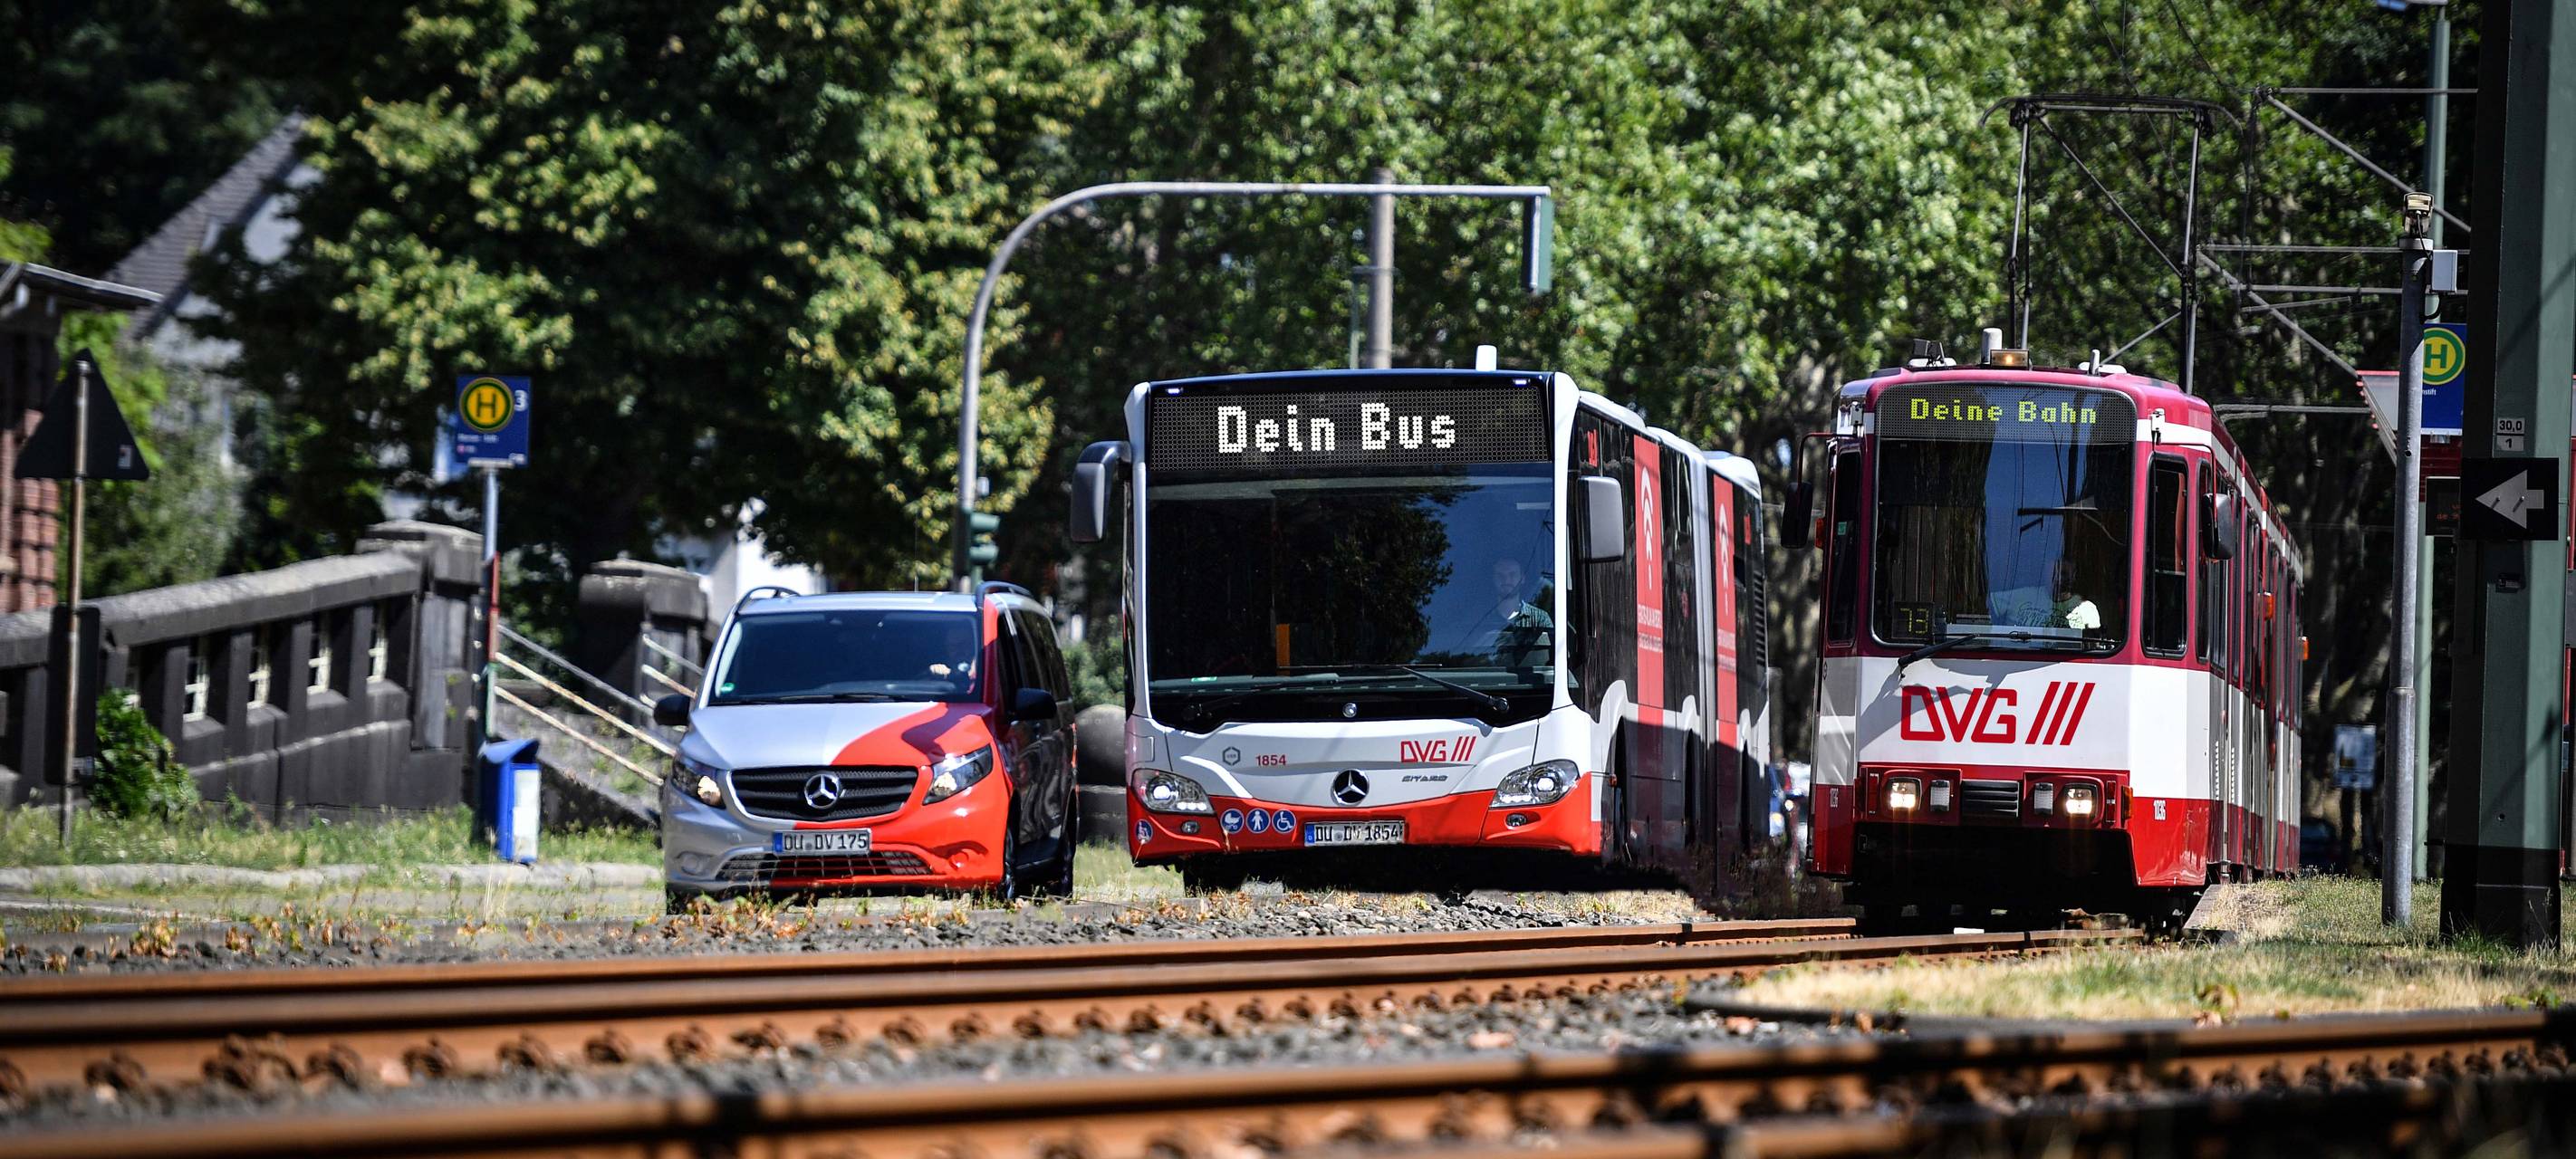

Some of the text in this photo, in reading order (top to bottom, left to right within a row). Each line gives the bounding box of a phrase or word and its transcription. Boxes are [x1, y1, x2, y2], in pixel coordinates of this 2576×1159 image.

[2424, 343, 2447, 369] H
[476, 392, 497, 418] H
[514, 389, 528, 412] 3
[1910, 398, 2096, 424] Deine Bahn
[1217, 402, 1456, 453] Dein Bus
[2499, 419, 2523, 433] 30,0
[2505, 437, 2513, 448] 1
[1899, 608, 1928, 634] 73
[1900, 685, 2017, 744] DVG
[1254, 753, 1287, 766] 1854
[1400, 739, 1447, 763] DVG
[783, 833, 868, 850] DU DV 175
[1315, 826, 1333, 842] DU
[1364, 824, 1399, 842] 1854
